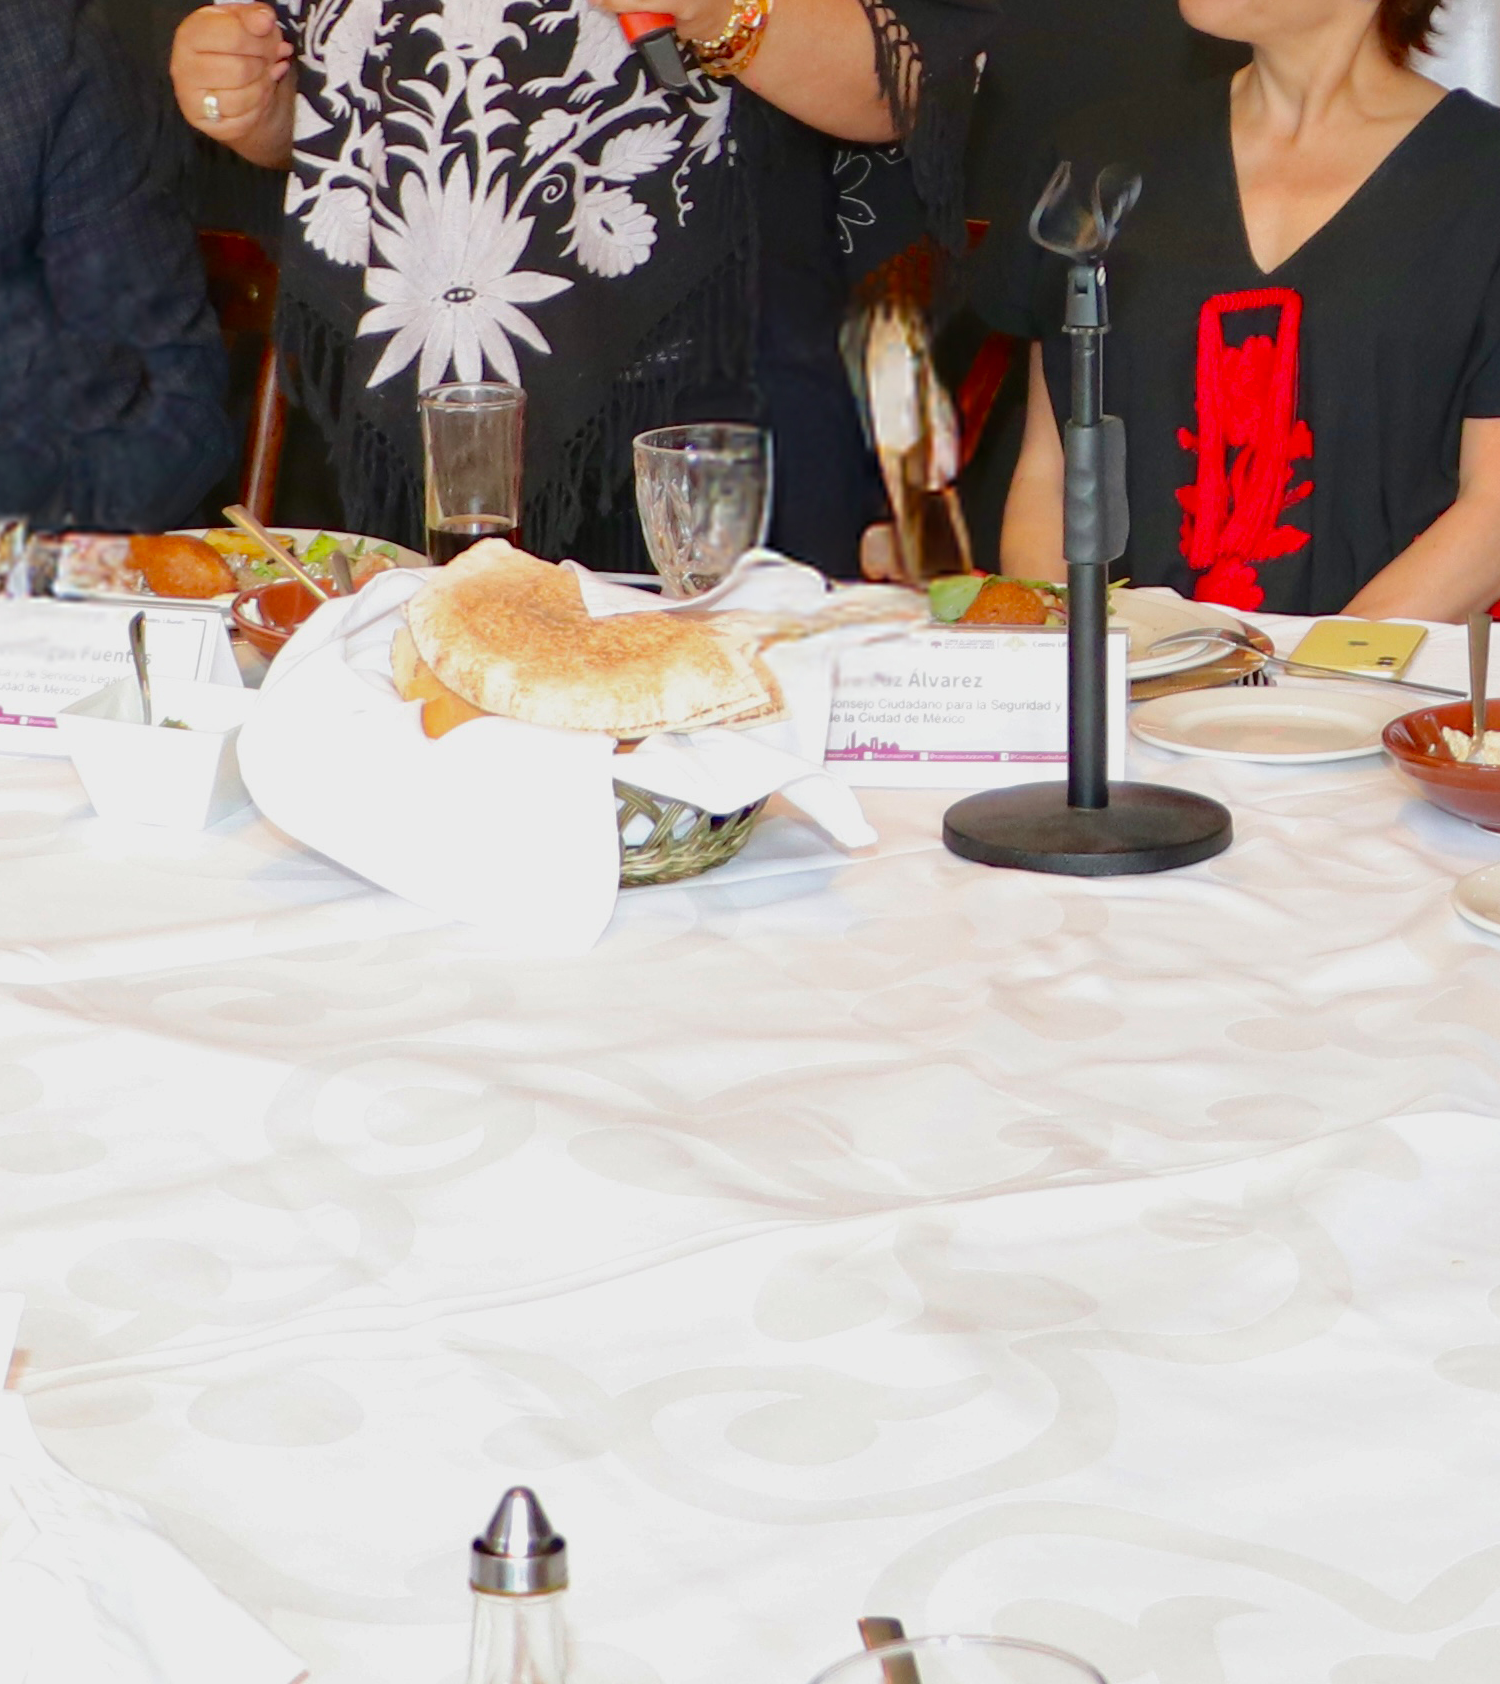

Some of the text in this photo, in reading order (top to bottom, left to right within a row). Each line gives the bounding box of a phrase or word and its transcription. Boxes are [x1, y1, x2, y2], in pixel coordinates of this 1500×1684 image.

[80, 645, 152, 665] Fuents
[91, 673, 121, 688] Legal
[908, 668, 983, 688] Álvarez
[27, 682, 40, 693] de
[878, 698, 943, 710] Ciudadano
[946, 701, 972, 711] para
[977, 700, 986, 710] la
[991, 699, 1051, 713] Seguridad
[1055, 702, 1062, 713] y
[845, 712, 855, 723] la
[858, 712, 901, 723] Ciudad
[905, 712, 919, 724] de
[923, 712, 965, 724] México
